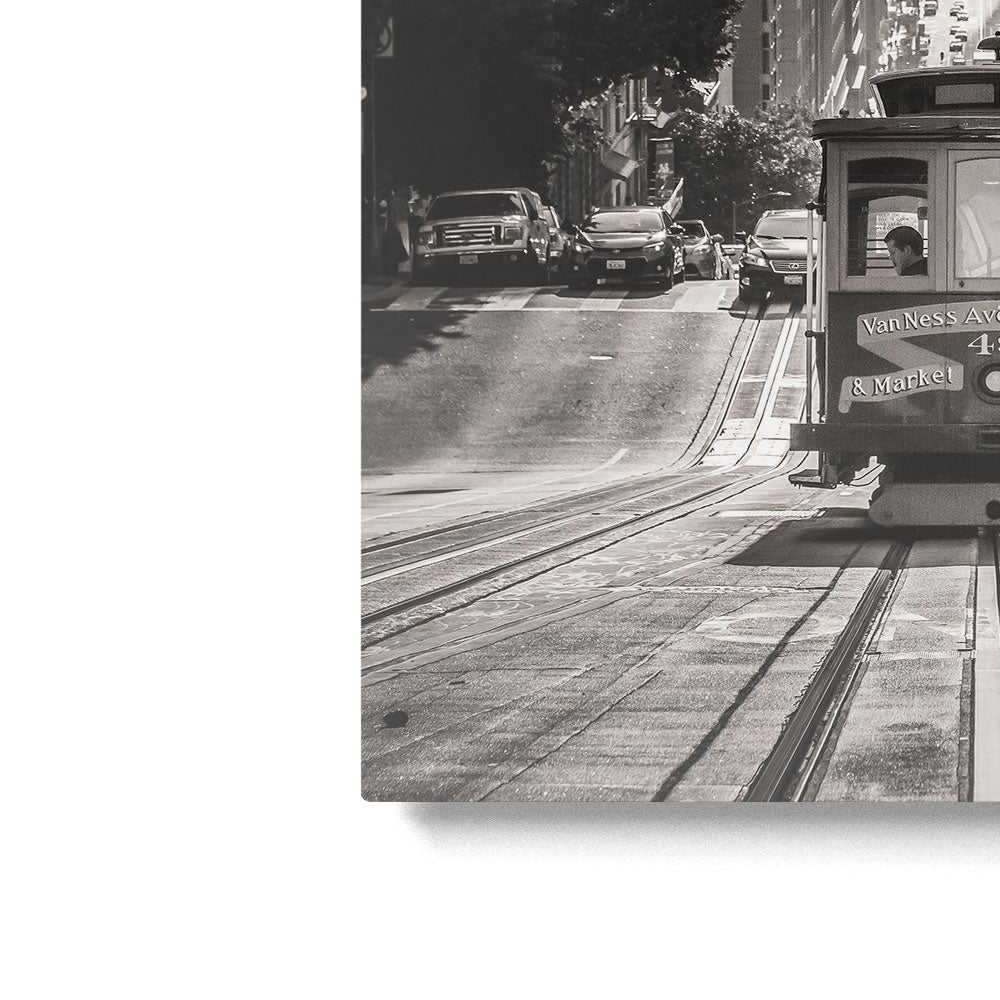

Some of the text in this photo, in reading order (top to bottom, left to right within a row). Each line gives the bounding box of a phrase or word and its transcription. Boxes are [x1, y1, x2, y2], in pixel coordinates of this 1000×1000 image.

[862, 316, 901, 336] Van
[903, 310, 958, 331] Ness
[852, 366, 954, 396] & Market
